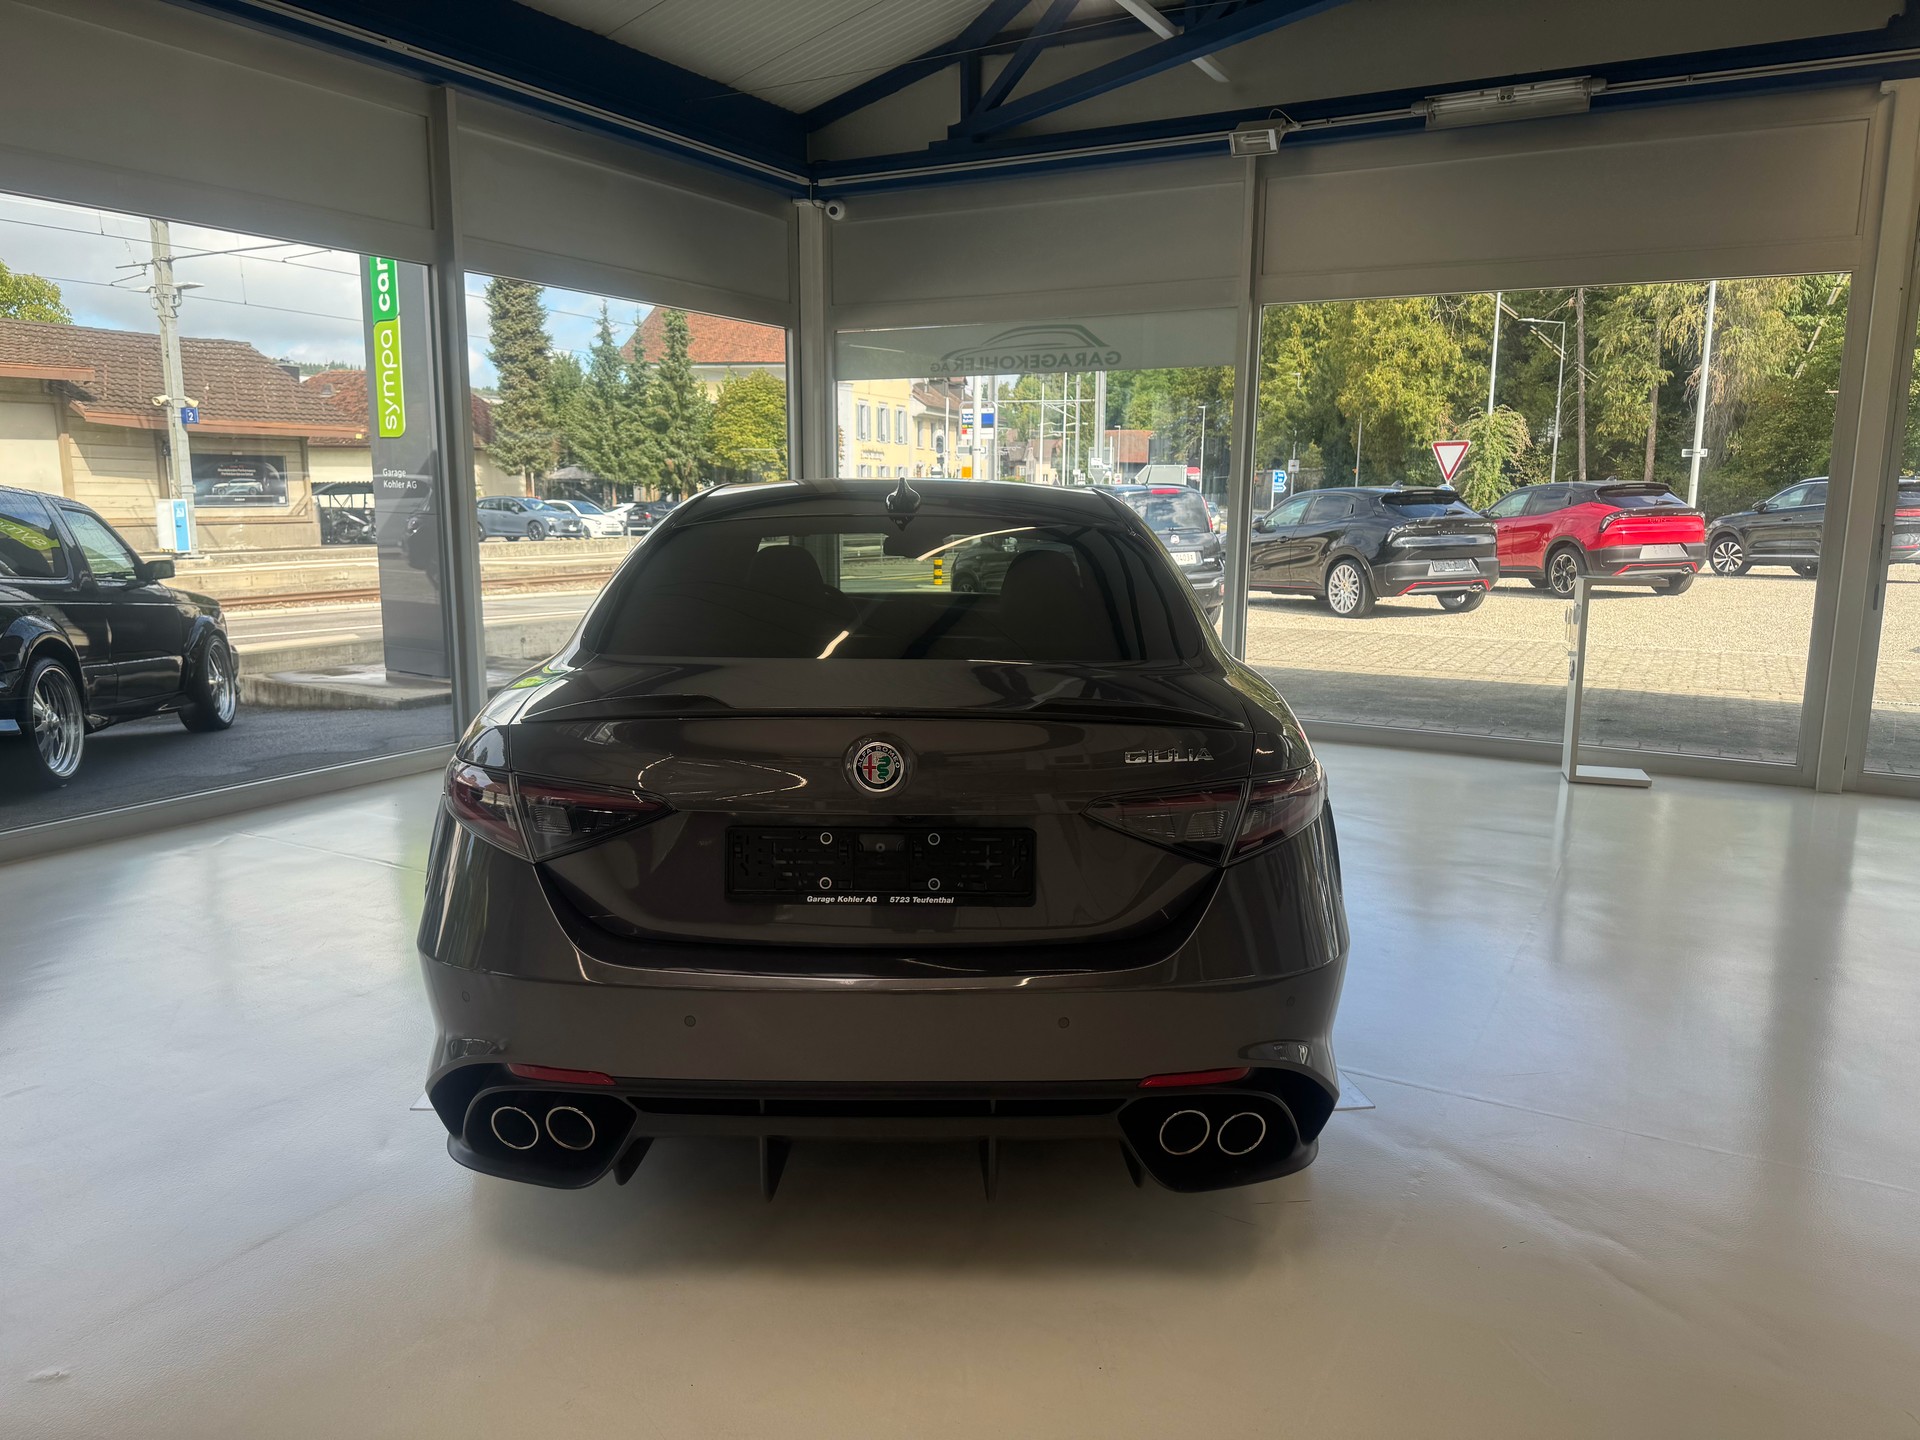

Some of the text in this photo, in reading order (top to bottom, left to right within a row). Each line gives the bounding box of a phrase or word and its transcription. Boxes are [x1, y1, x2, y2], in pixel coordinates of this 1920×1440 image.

[376, 257, 400, 430] sympa car
[188, 412, 194, 421] 2
[382, 468, 407, 478] Garage
[383, 480, 418, 489] Kohler AG
[857, 745, 901, 769] ALFA ROMEO
[1124, 747, 1215, 764] GIULIA
[806, 895, 836, 904] Garage
[837, 895, 864, 903] Kohler
[912, 896, 955, 904] Teufenthal
